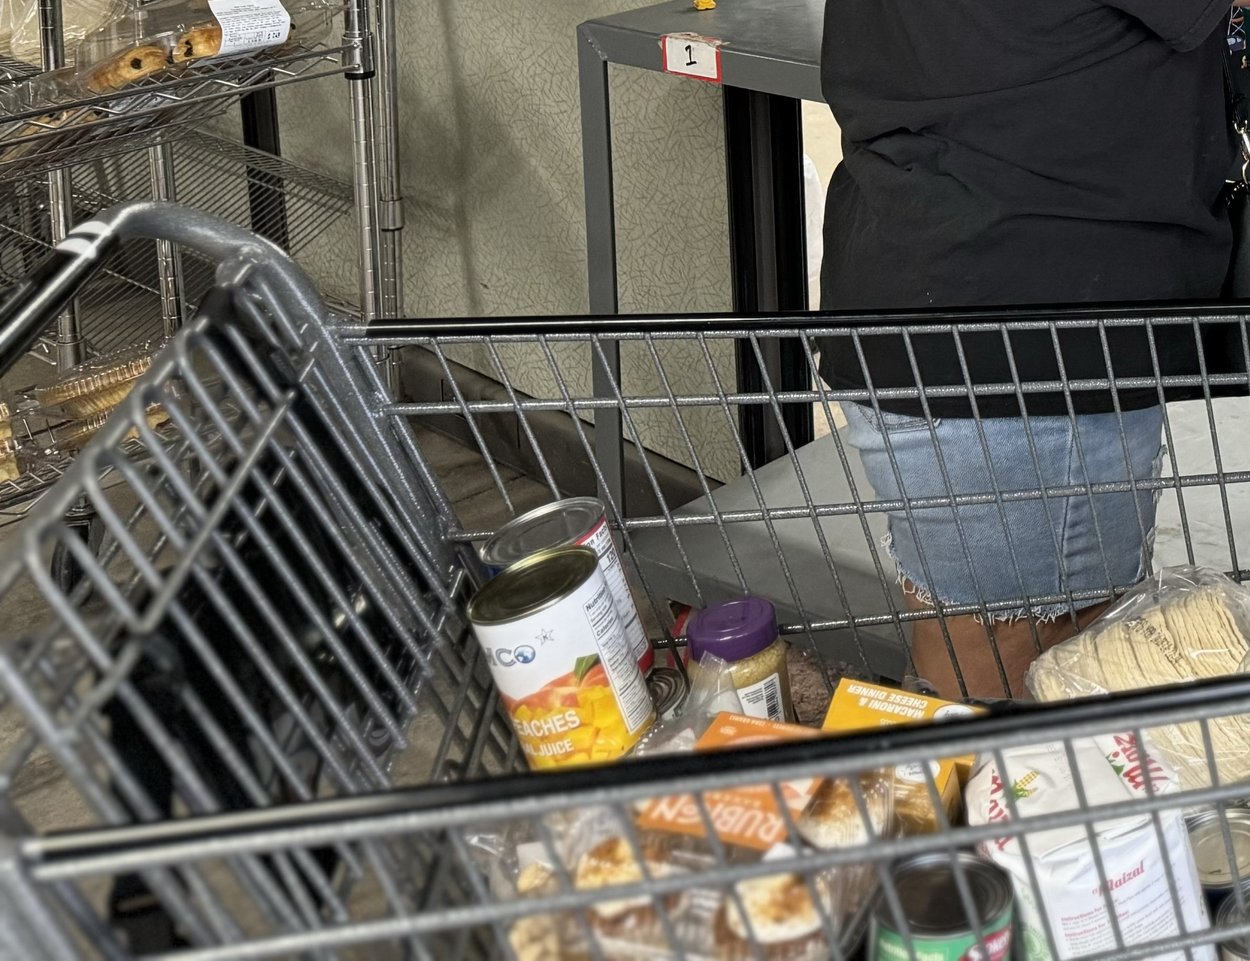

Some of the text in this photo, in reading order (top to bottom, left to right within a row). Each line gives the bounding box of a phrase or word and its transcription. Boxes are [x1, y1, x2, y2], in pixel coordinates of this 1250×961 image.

[684, 44, 698, 67] 1
[847, 683, 929, 709] CHEESE DINNER
[857, 697, 925, 717] MACARONI &
[537, 739, 575, 757] JUICE
